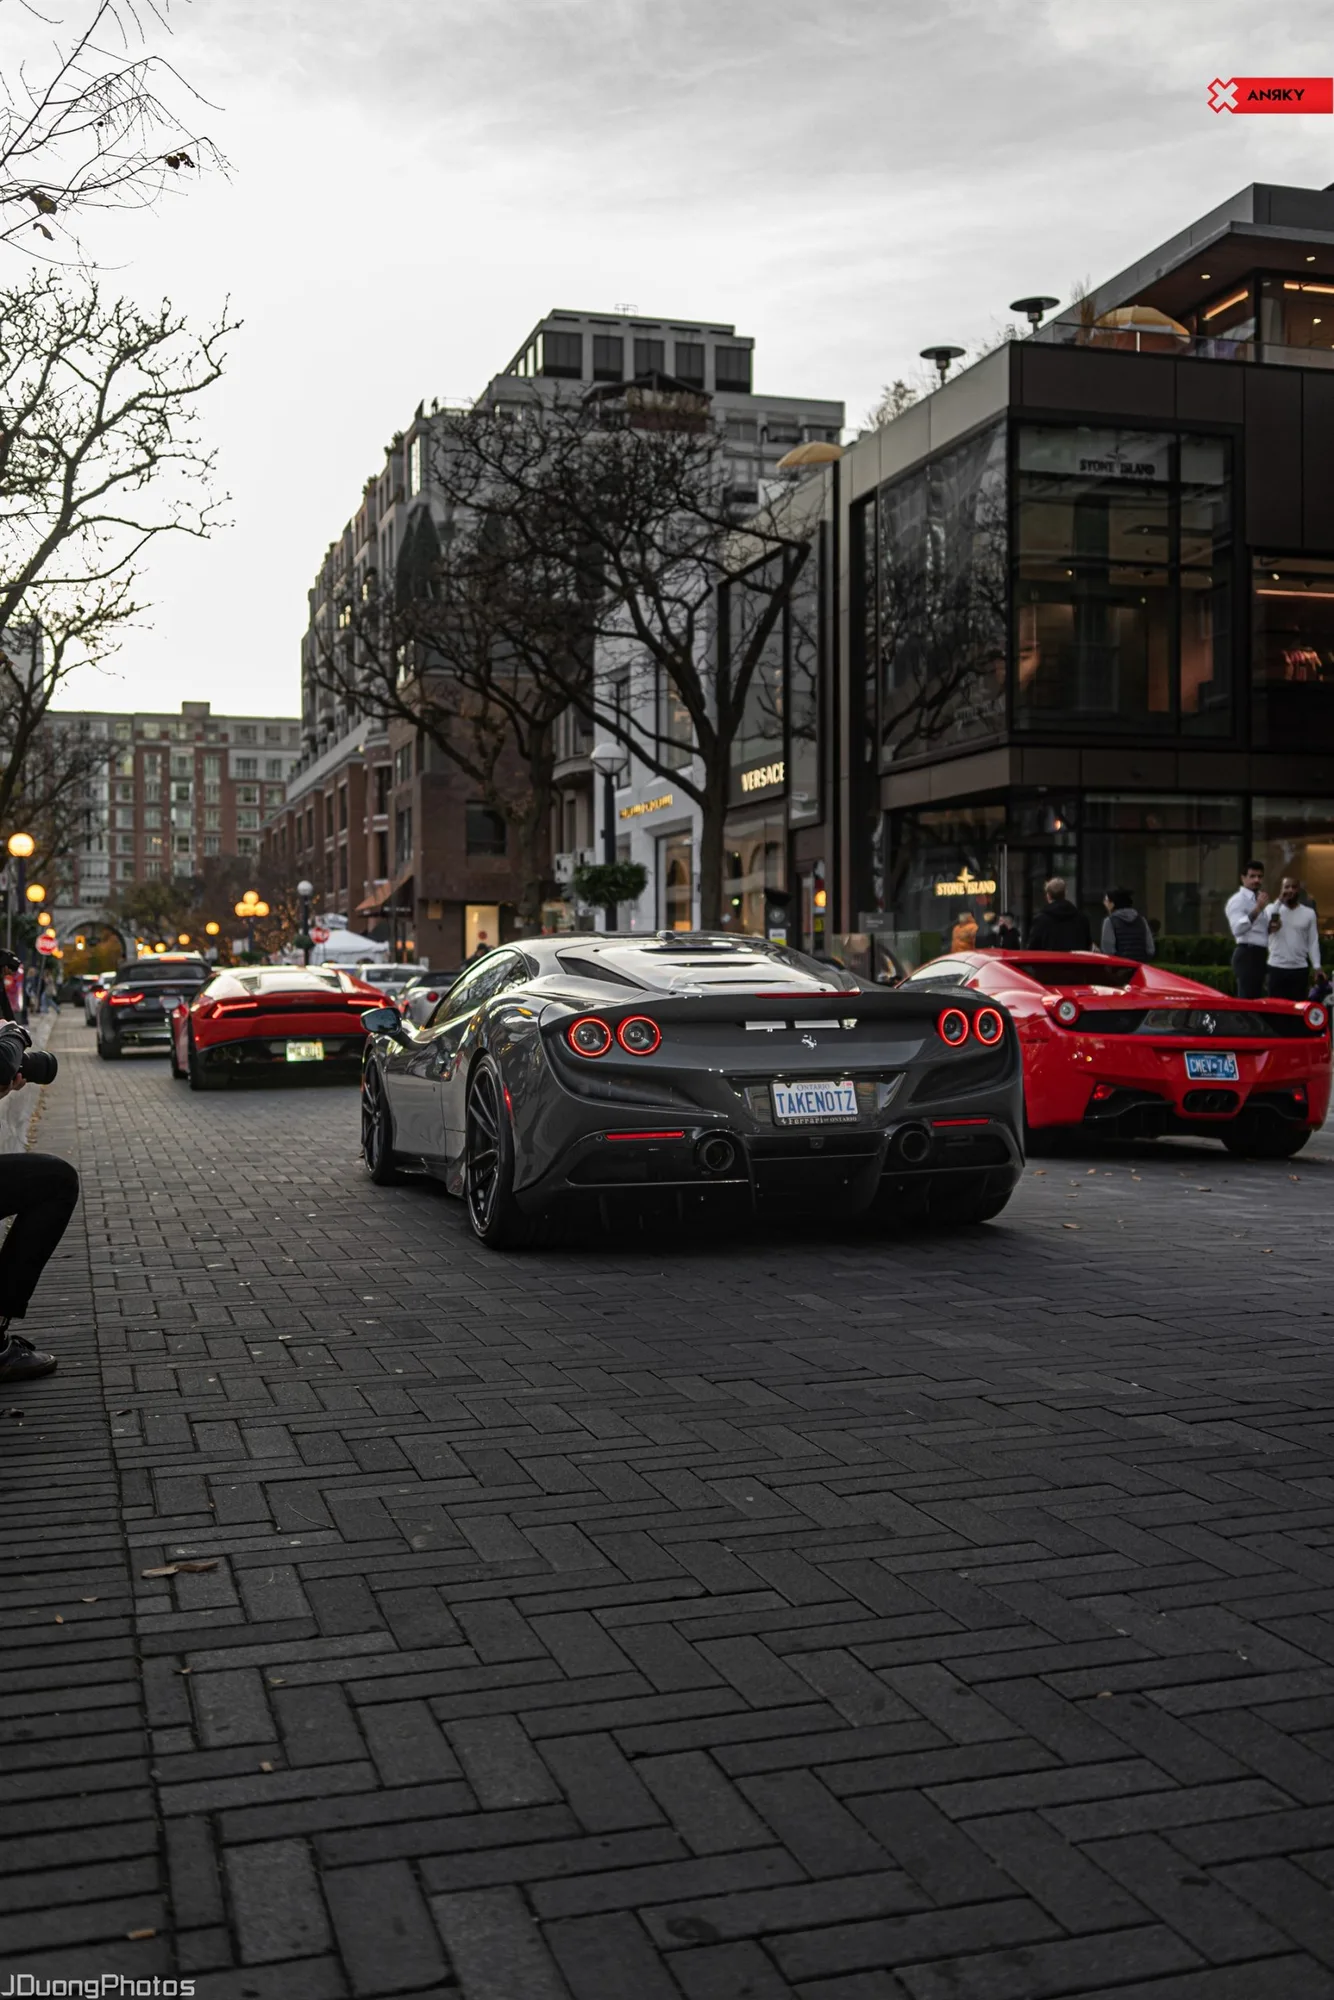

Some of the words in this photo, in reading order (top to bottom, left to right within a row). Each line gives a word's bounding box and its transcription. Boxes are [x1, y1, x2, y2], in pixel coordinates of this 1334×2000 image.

[741, 761, 785, 792] VERSACE
[936, 882, 965, 896] STONE
[967, 880, 996, 894] ISLAND
[1217, 1058, 1235, 1073] 745
[776, 1090, 855, 1114] TAKENOTZ
